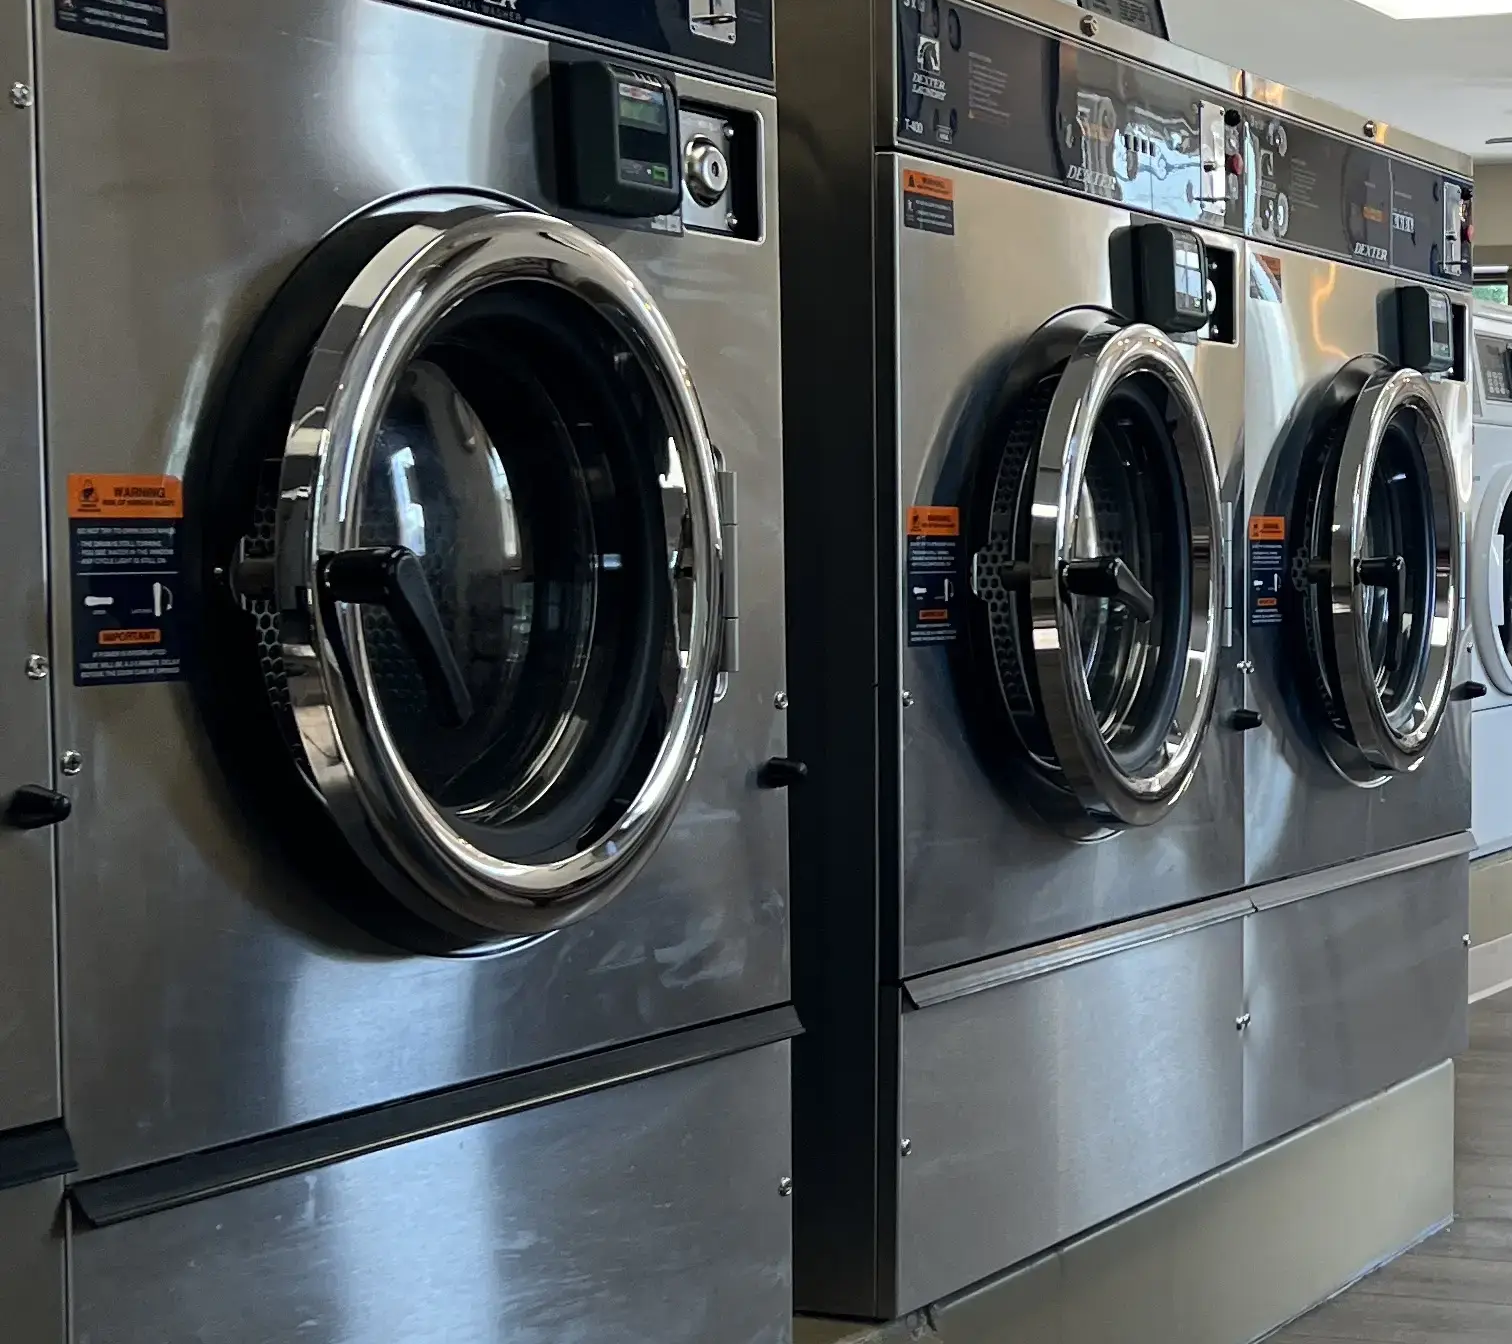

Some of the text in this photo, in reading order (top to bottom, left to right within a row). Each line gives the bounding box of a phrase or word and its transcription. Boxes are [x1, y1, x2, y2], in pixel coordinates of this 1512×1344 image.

[912, 72, 946, 91] DEXTER
[1066, 164, 1117, 191] DEXTER
[1353, 241, 1388, 261] DEXTER
